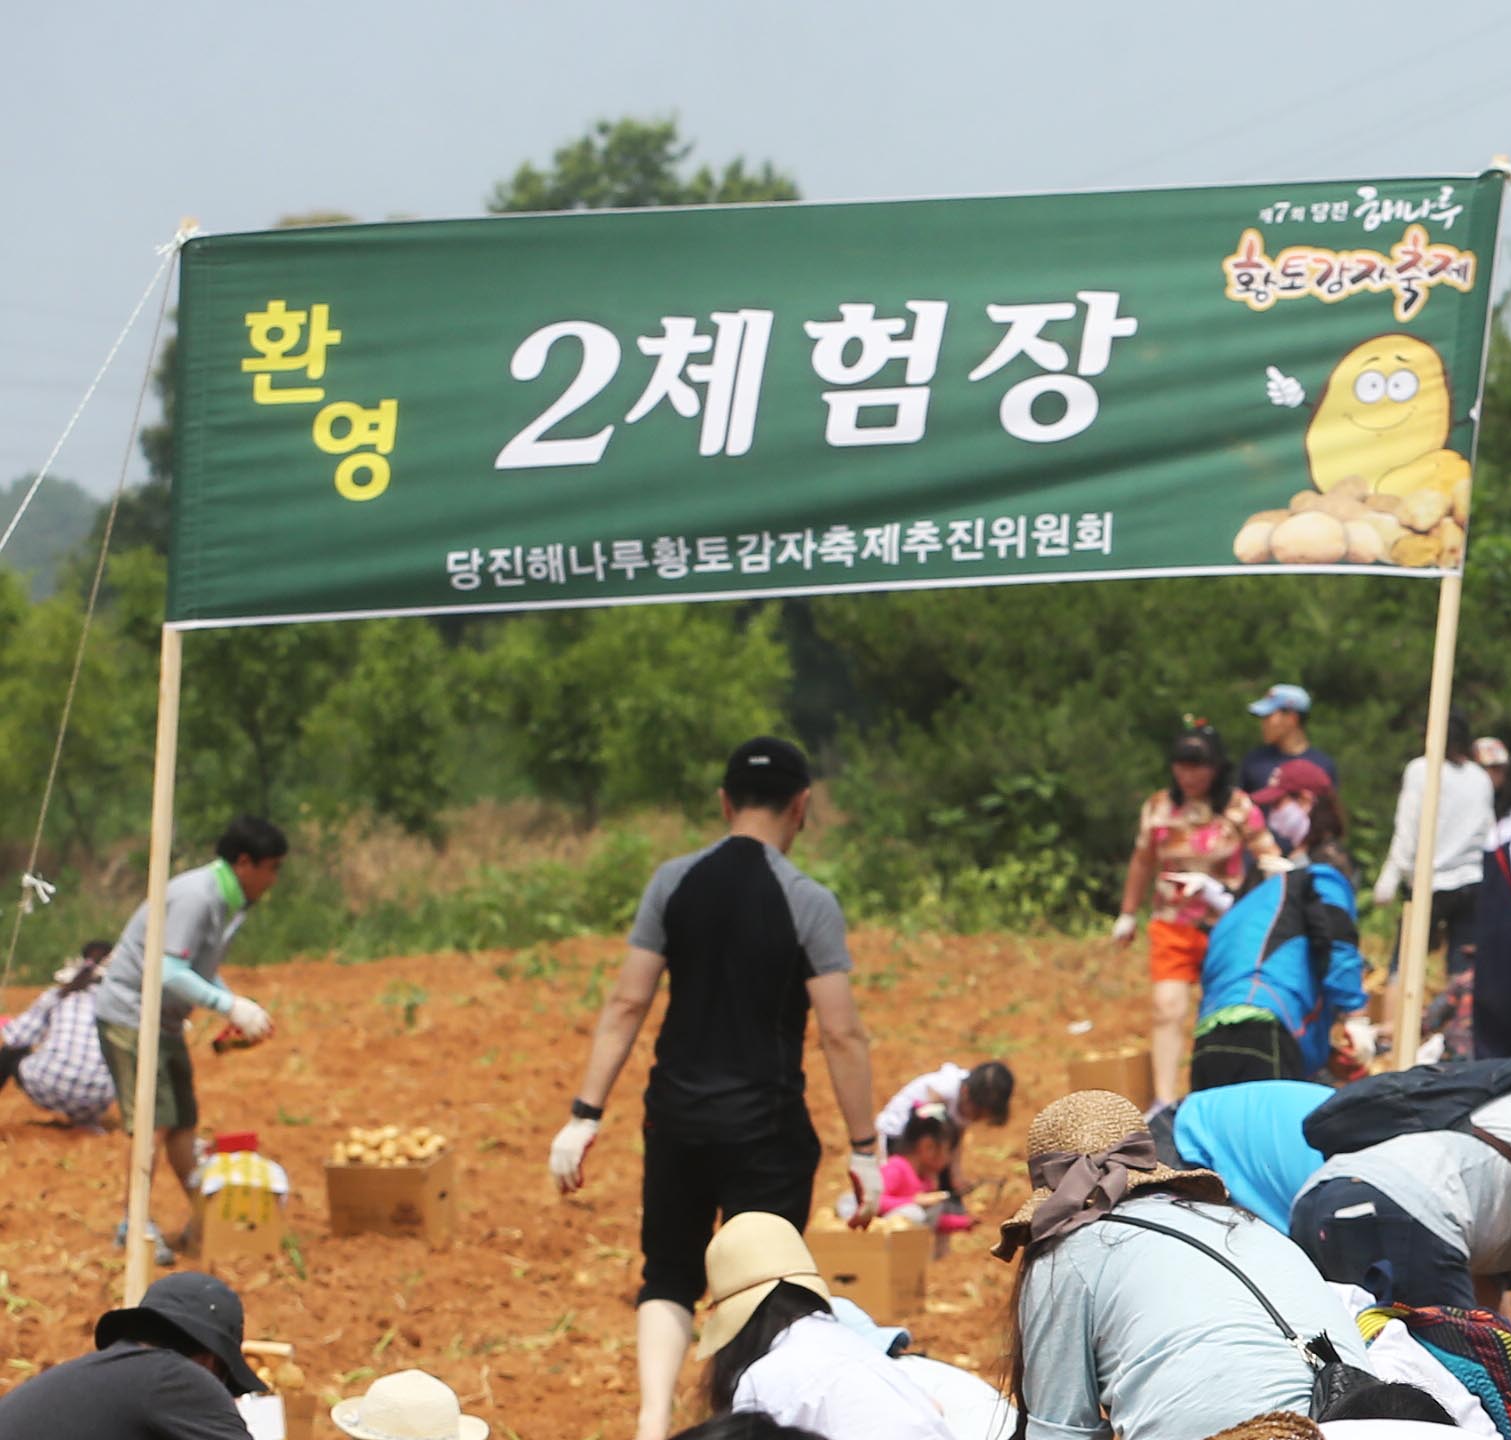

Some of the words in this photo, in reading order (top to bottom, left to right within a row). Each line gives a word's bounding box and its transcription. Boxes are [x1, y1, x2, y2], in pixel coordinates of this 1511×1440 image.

[1310, 200, 1350, 222] 당진
[1353, 186, 1463, 232] 해나루
[1226, 226, 1474, 320] 황토감자축제
[445, 511, 1114, 591] 당진해나루황토감자축제추진위원회
